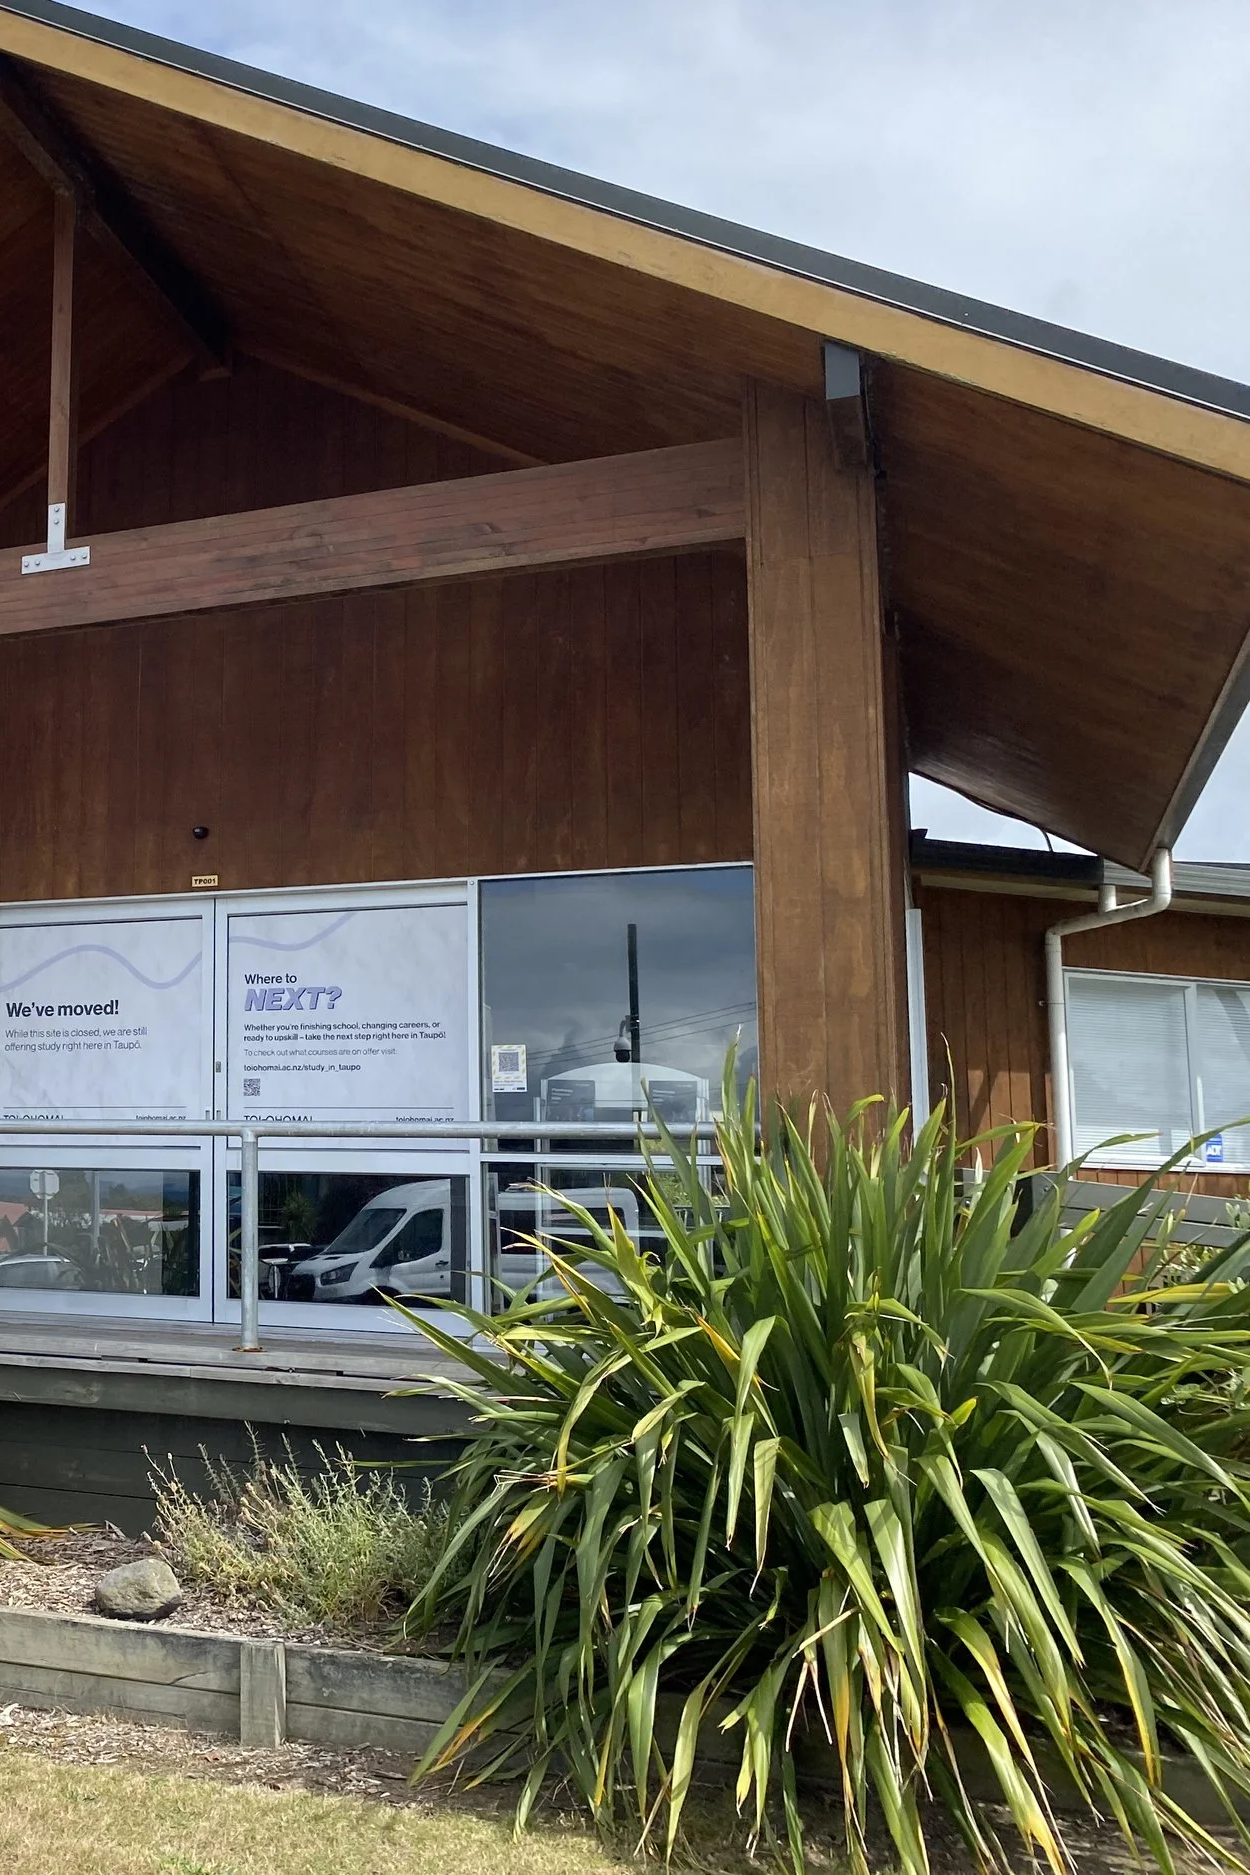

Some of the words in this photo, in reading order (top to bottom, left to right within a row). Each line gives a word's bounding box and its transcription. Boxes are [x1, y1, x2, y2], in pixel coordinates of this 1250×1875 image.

[244, 973, 283, 984] Where
[285, 972, 298, 984] to
[244, 985, 343, 1011] NEXT?
[6, 1001, 55, 1018] We've
[57, 999, 119, 1017] moved!
[5, 1029, 29, 1038] While
[30, 1028, 45, 1038] this
[46, 1028, 62, 1038] site
[63, 1028, 70, 1037] is
[70, 1027, 102, 1038] closed,
[102, 1029, 116, 1037] we
[116, 1028, 132, 1036] are
[132, 1026, 148, 1036] still
[243, 1023, 275, 1032] Whether
[276, 1022, 300, 1032] you're
[300, 1021, 332, 1032] finishing
[332, 1020, 361, 1030] school,
[361, 1020, 398, 1031] changing
[398, 1021, 431, 1030] careers,
[243, 1034, 264, 1042] ready
[274, 1033, 299, 1042] upskill
[305, 1033, 322, 1041] take
[322, 1032, 336, 1040] the
[336, 1032, 354, 1040] next
[354, 1032, 372, 1041] step
[372, 1031, 391, 1041] right
[391, 1031, 410, 1039] here
[410, 1031, 418, 1039] in
[4, 1042, 37, 1053] offering
[37, 1041, 61, 1053] study
[62, 1041, 82, 1052] right
[82, 1041, 103, 1050] here
[103, 1041, 112, 1050] in
[243, 1048, 253, 1056] To
[253, 1048, 276, 1057] check
[276, 1048, 289, 1056] out
[289, 1048, 308, 1056] what
[308, 1048, 338, 1056] courses
[338, 1048, 351, 1056] are
[351, 1048, 362, 1056] on
[362, 1047, 380, 1056] offer
